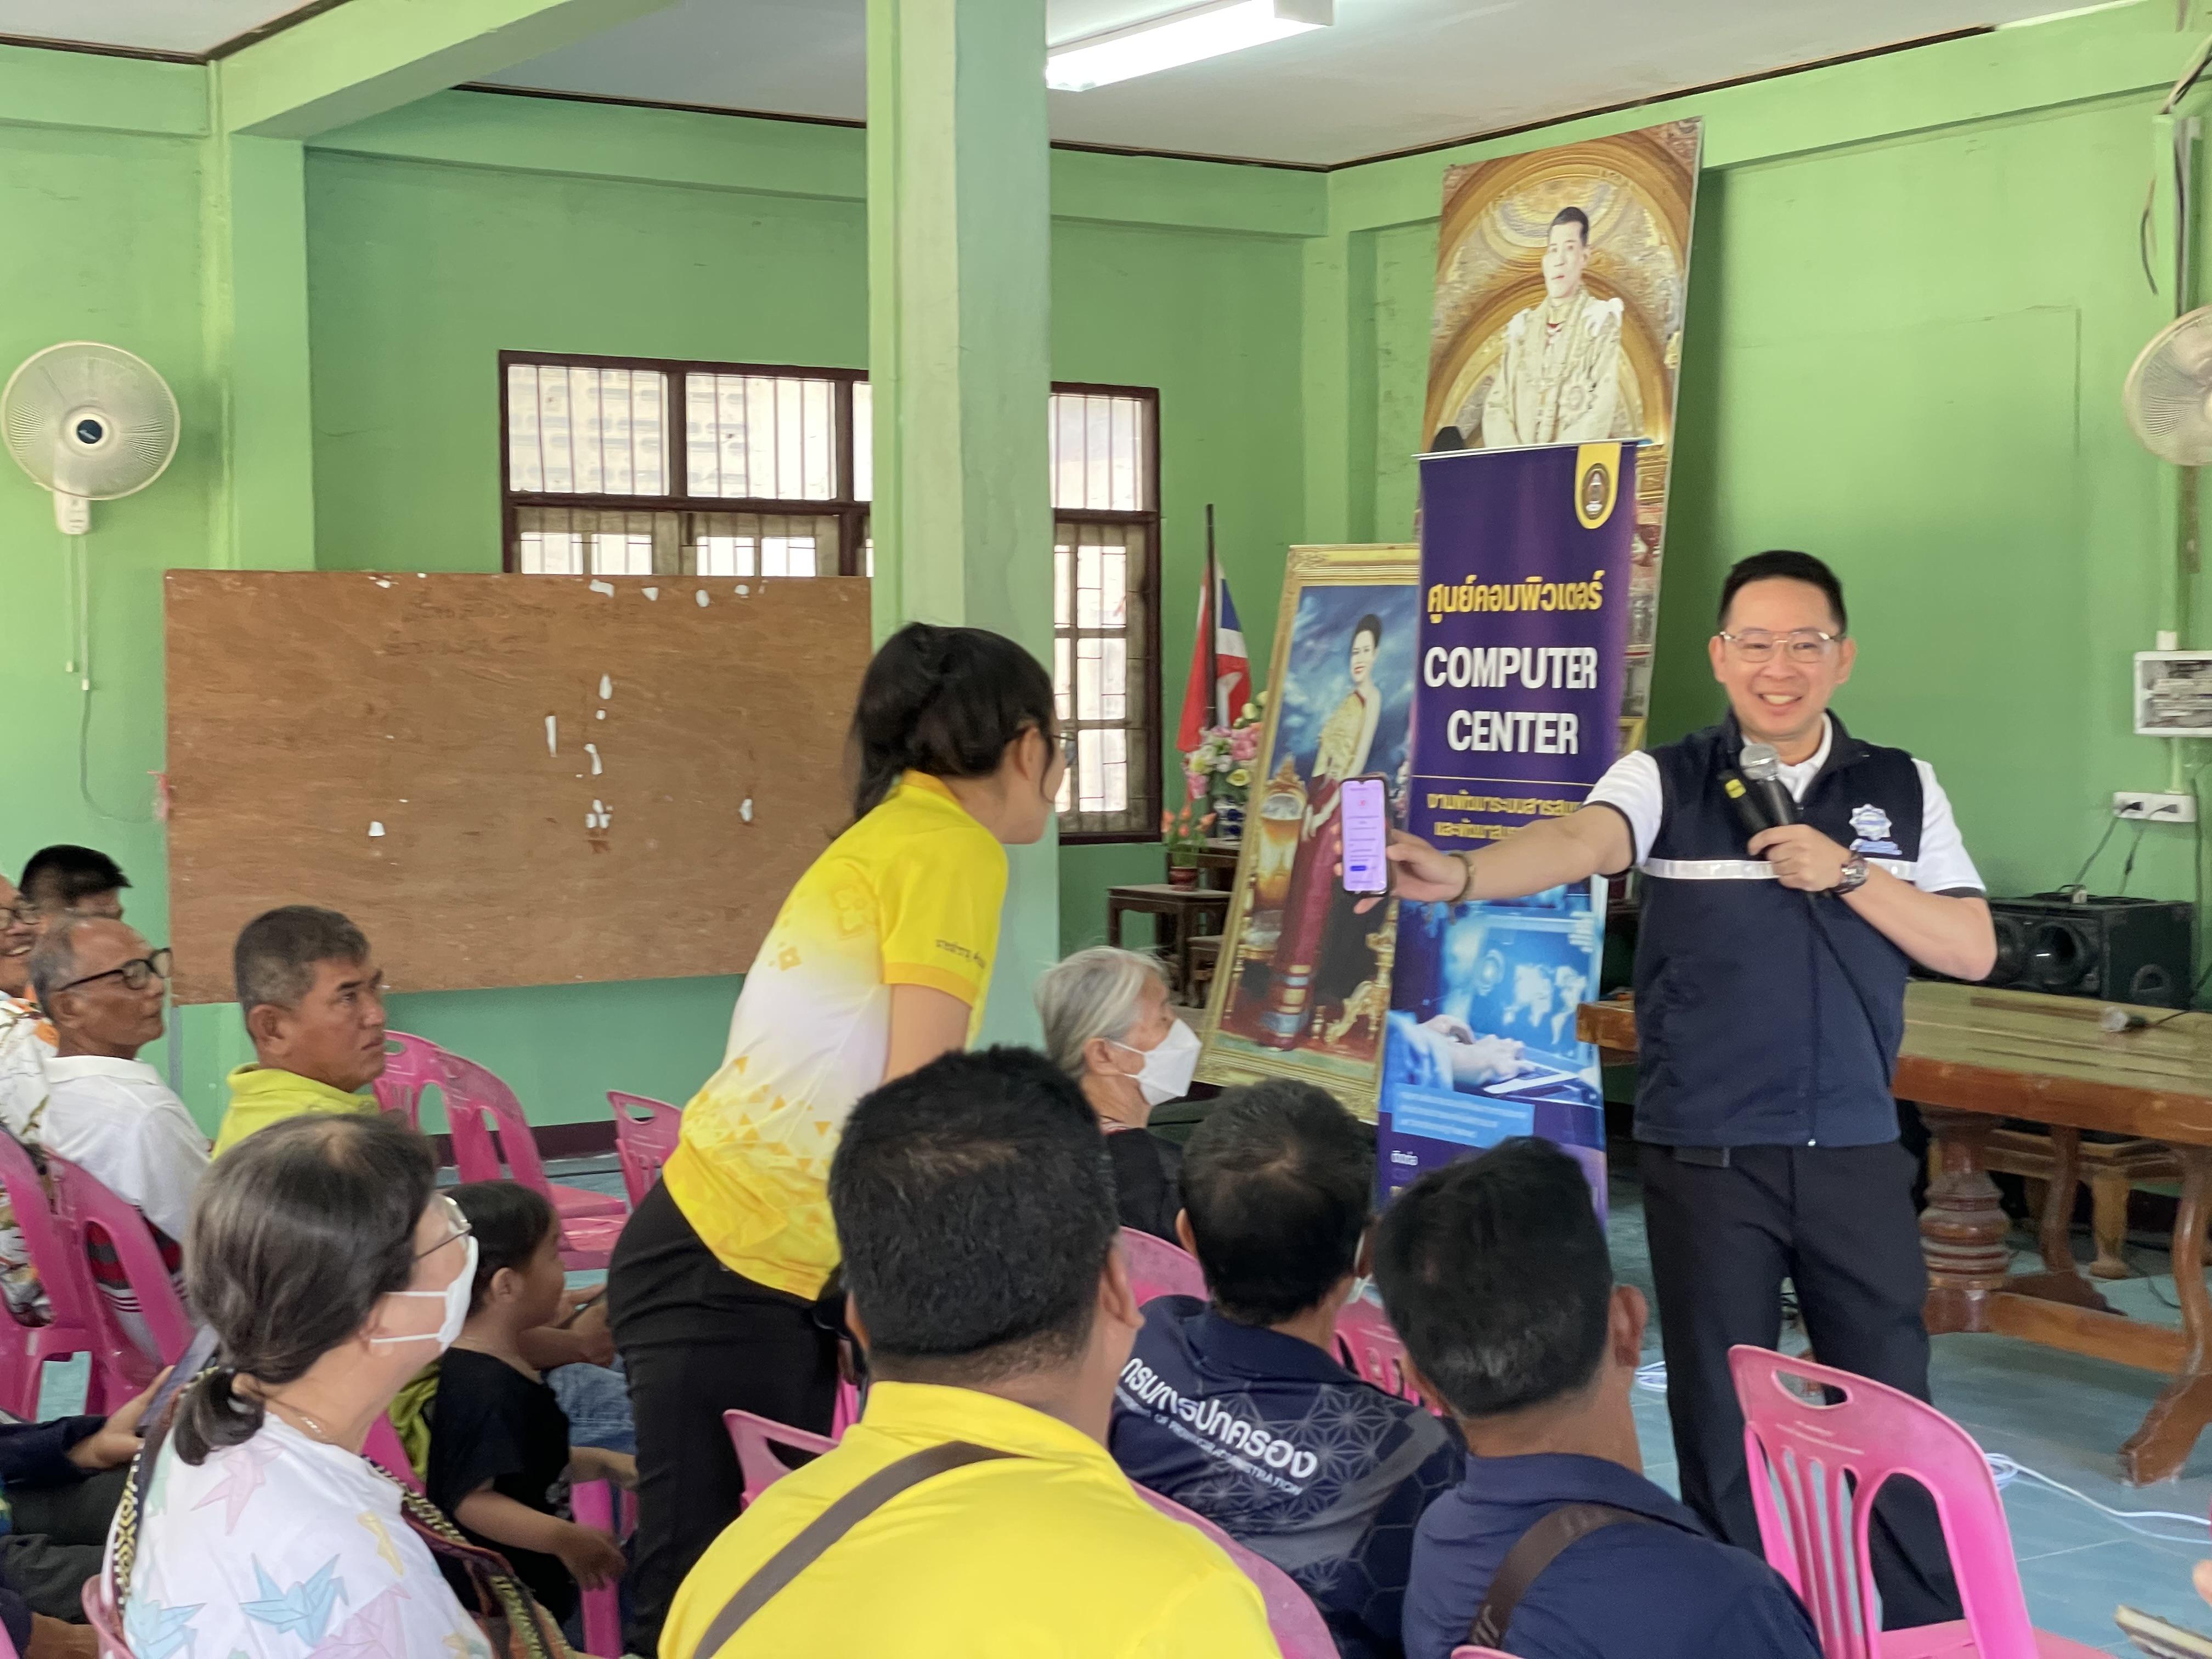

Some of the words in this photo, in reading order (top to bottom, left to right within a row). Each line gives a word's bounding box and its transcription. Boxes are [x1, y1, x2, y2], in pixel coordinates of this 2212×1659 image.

[1427, 570, 1605, 623] ศูนย์คอมพิวเตอร์
[1424, 647, 1598, 689] COMPUTER
[1447, 710, 1578, 754] CENTER
[1121, 1357, 1317, 1479] กรมการปกครอง
